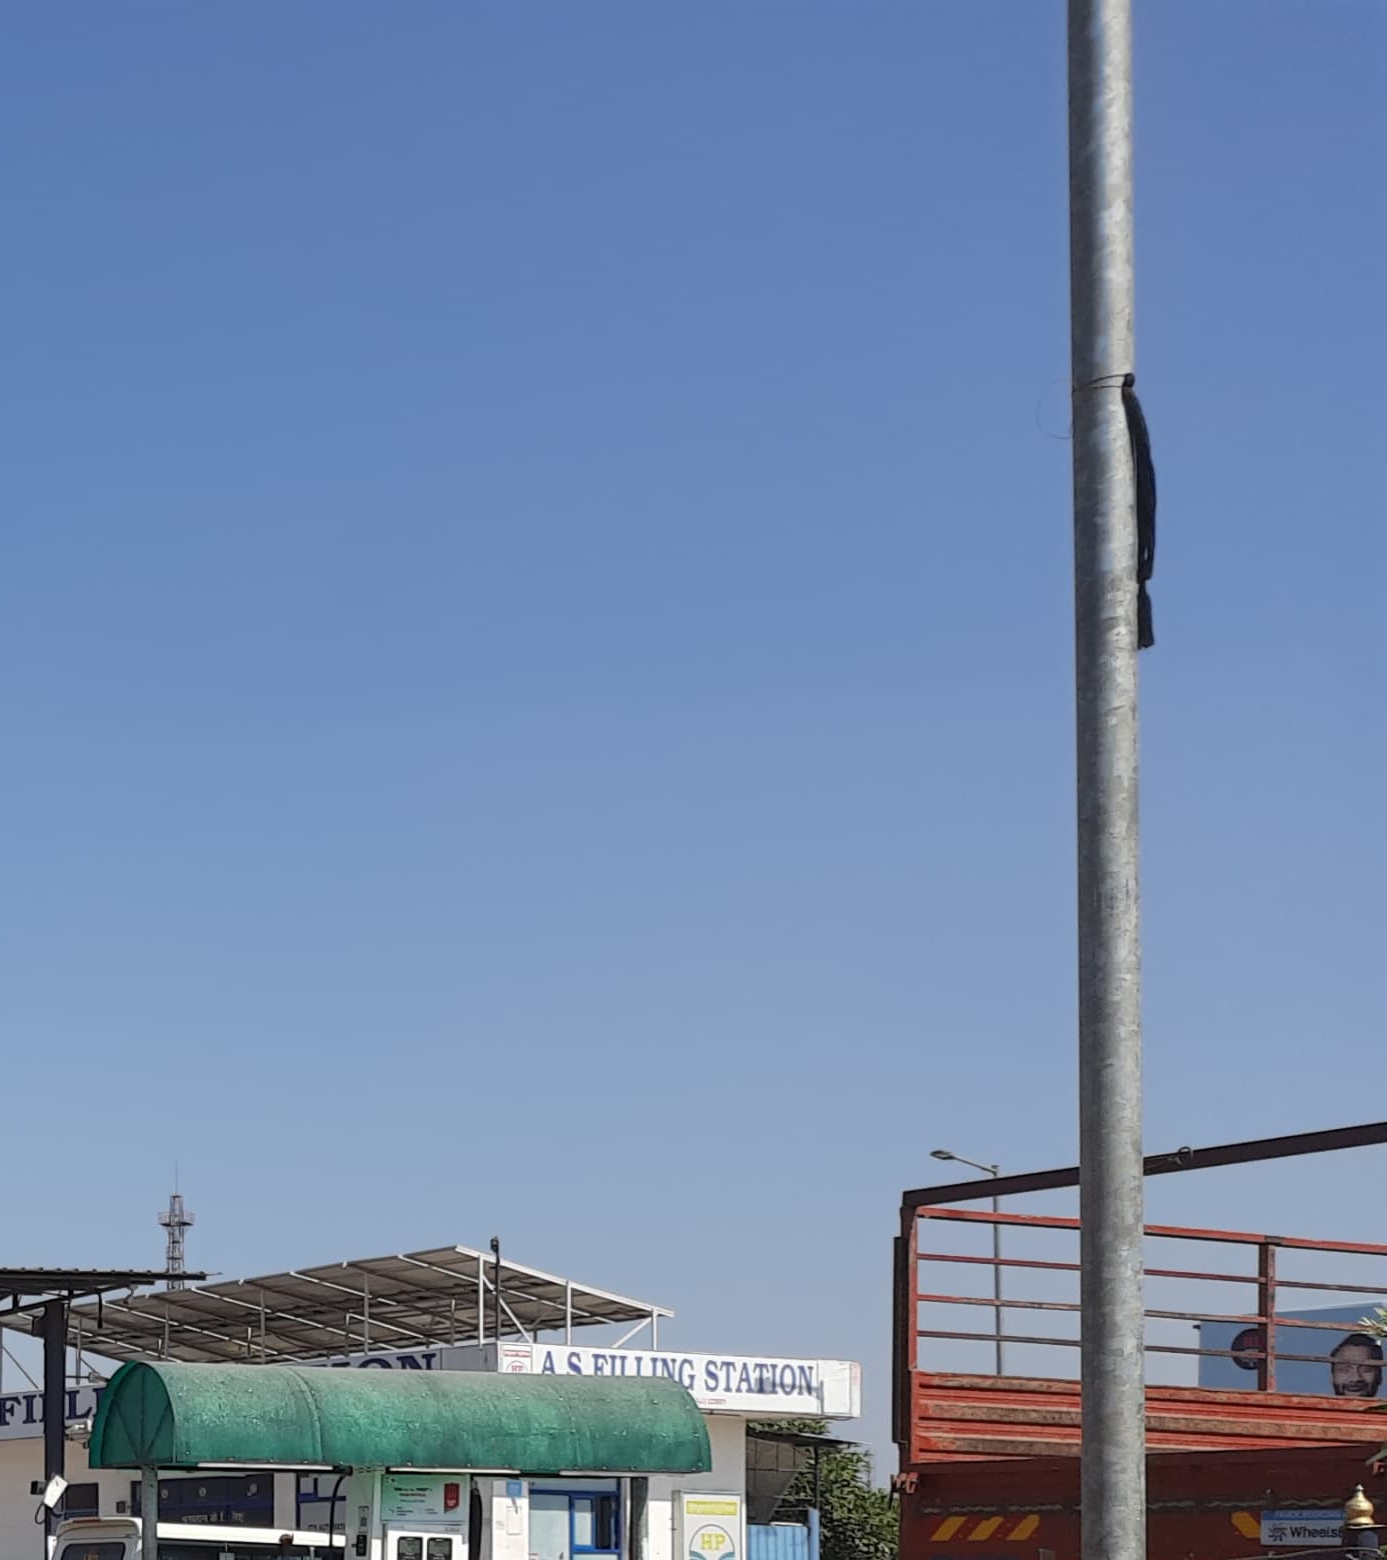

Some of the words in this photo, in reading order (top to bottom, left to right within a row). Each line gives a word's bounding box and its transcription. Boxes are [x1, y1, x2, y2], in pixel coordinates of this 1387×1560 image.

[541, 1350, 556, 1375] A
[567, 1351, 583, 1376] S
[704, 1359, 815, 1397] STATION
[700, 1533, 726, 1551] HP
